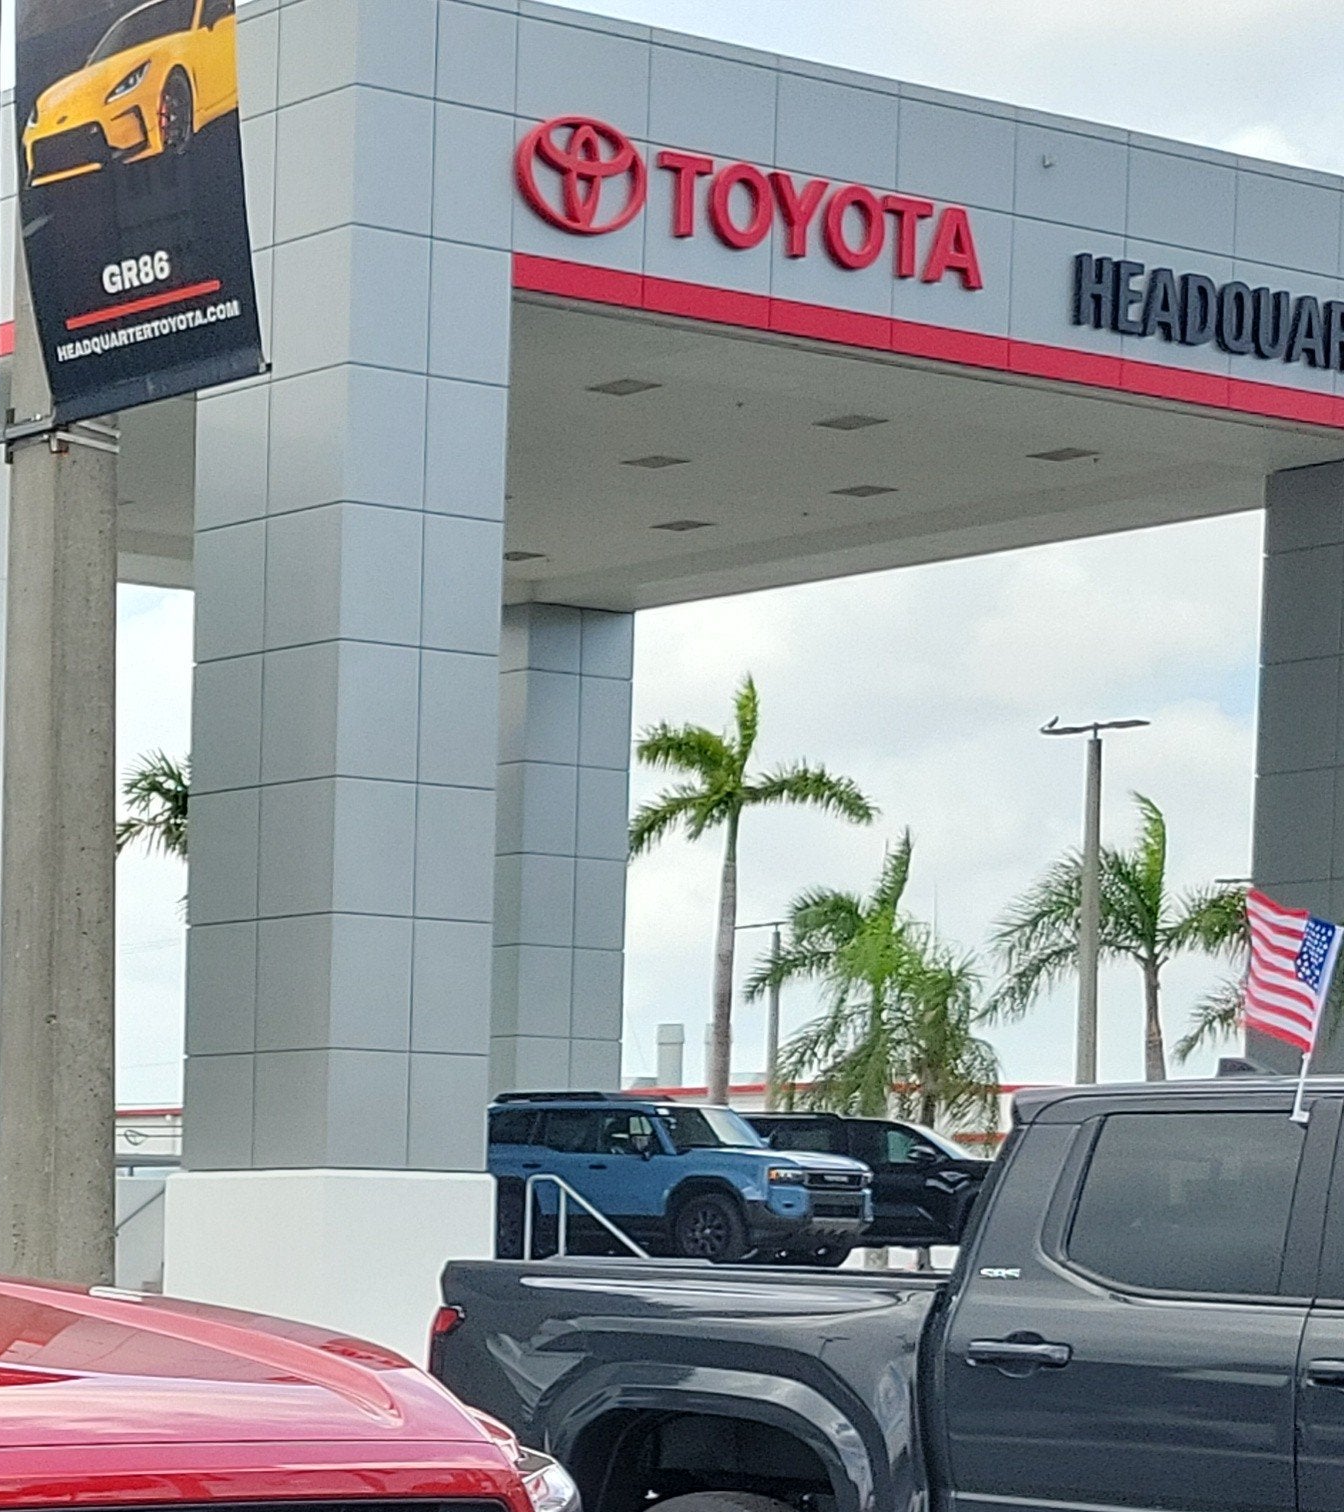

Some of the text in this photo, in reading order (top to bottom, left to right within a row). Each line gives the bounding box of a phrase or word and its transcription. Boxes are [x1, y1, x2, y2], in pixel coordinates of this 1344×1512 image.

[657, 150, 983, 291] TOYOTA
[101, 250, 171, 295] GR86
[56, 300, 241, 363] HEADQUARTERTOYOTA.COM
